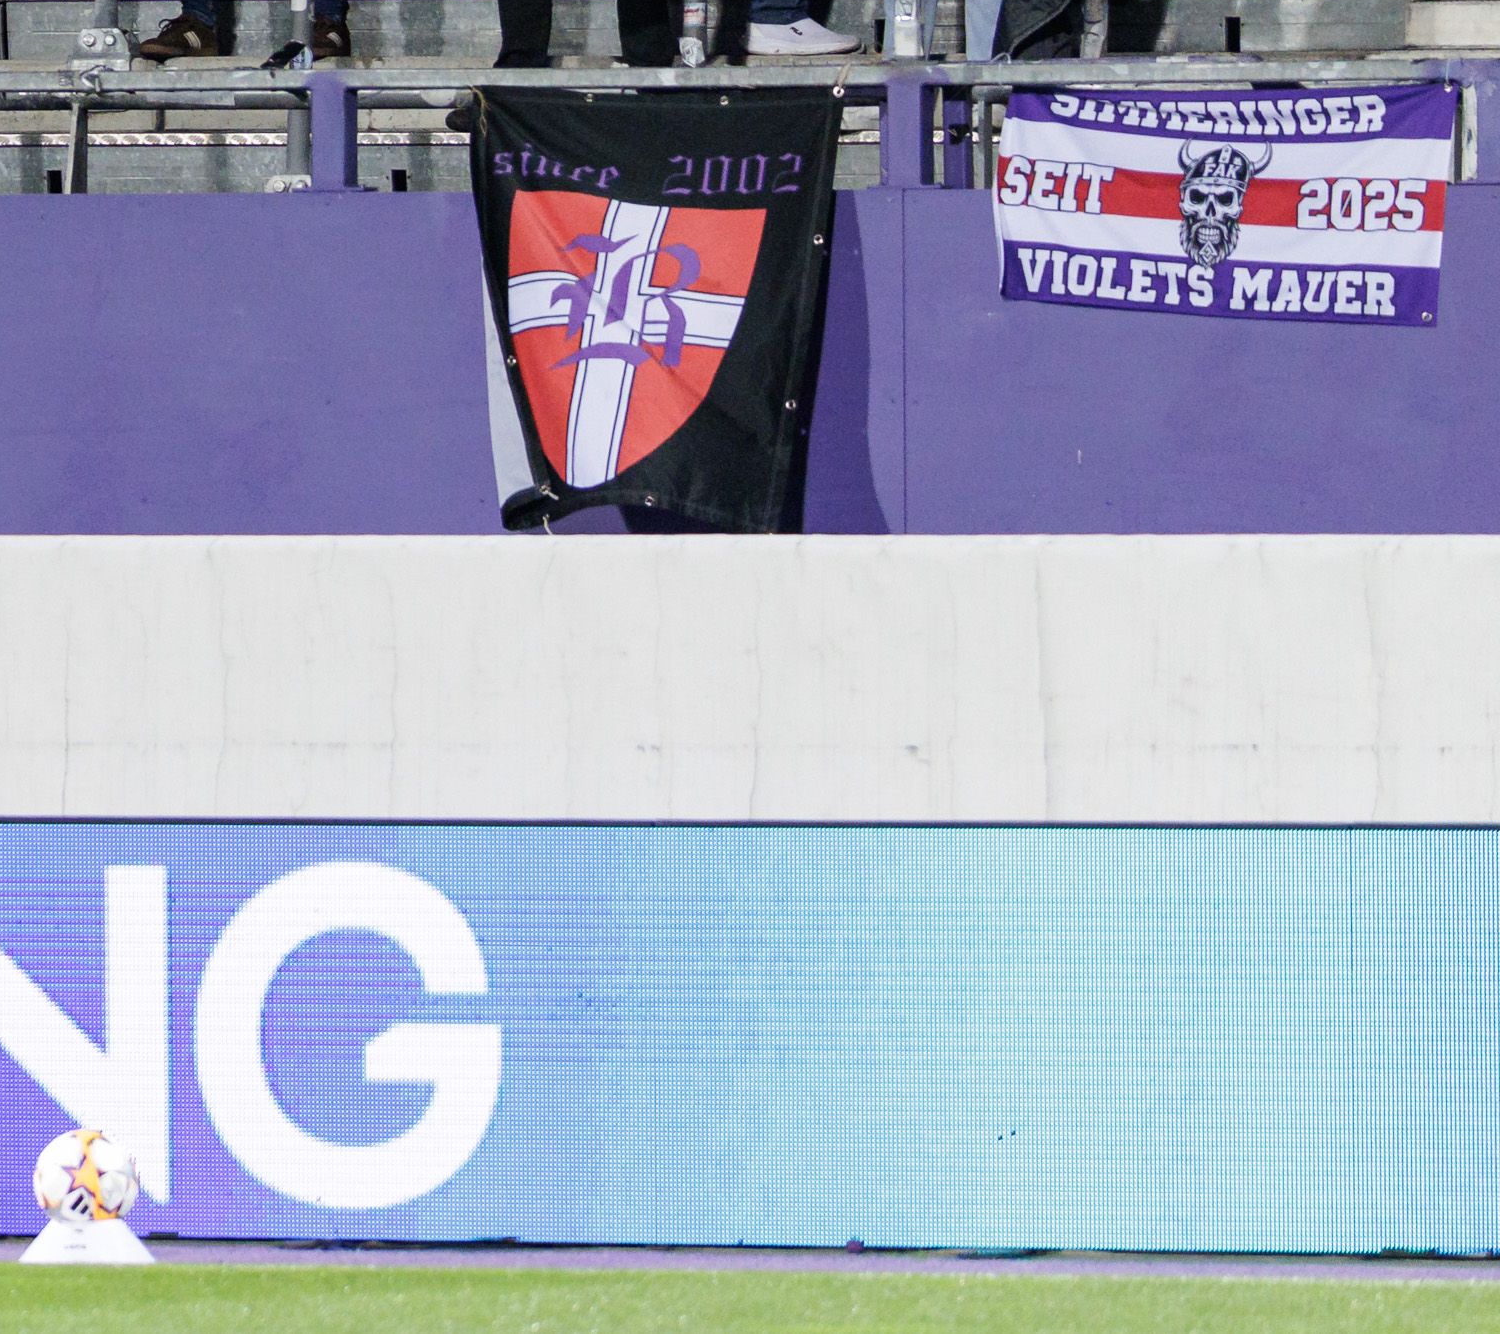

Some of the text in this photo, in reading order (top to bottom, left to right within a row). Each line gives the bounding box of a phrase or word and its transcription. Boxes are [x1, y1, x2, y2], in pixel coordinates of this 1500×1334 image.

[493, 139, 803, 198] since 2002
[998, 154, 1428, 232] SEIT 2025
[1202, 164, 1241, 180] FAK
[1017, 244, 1396, 317] VIOLETS MAUER
